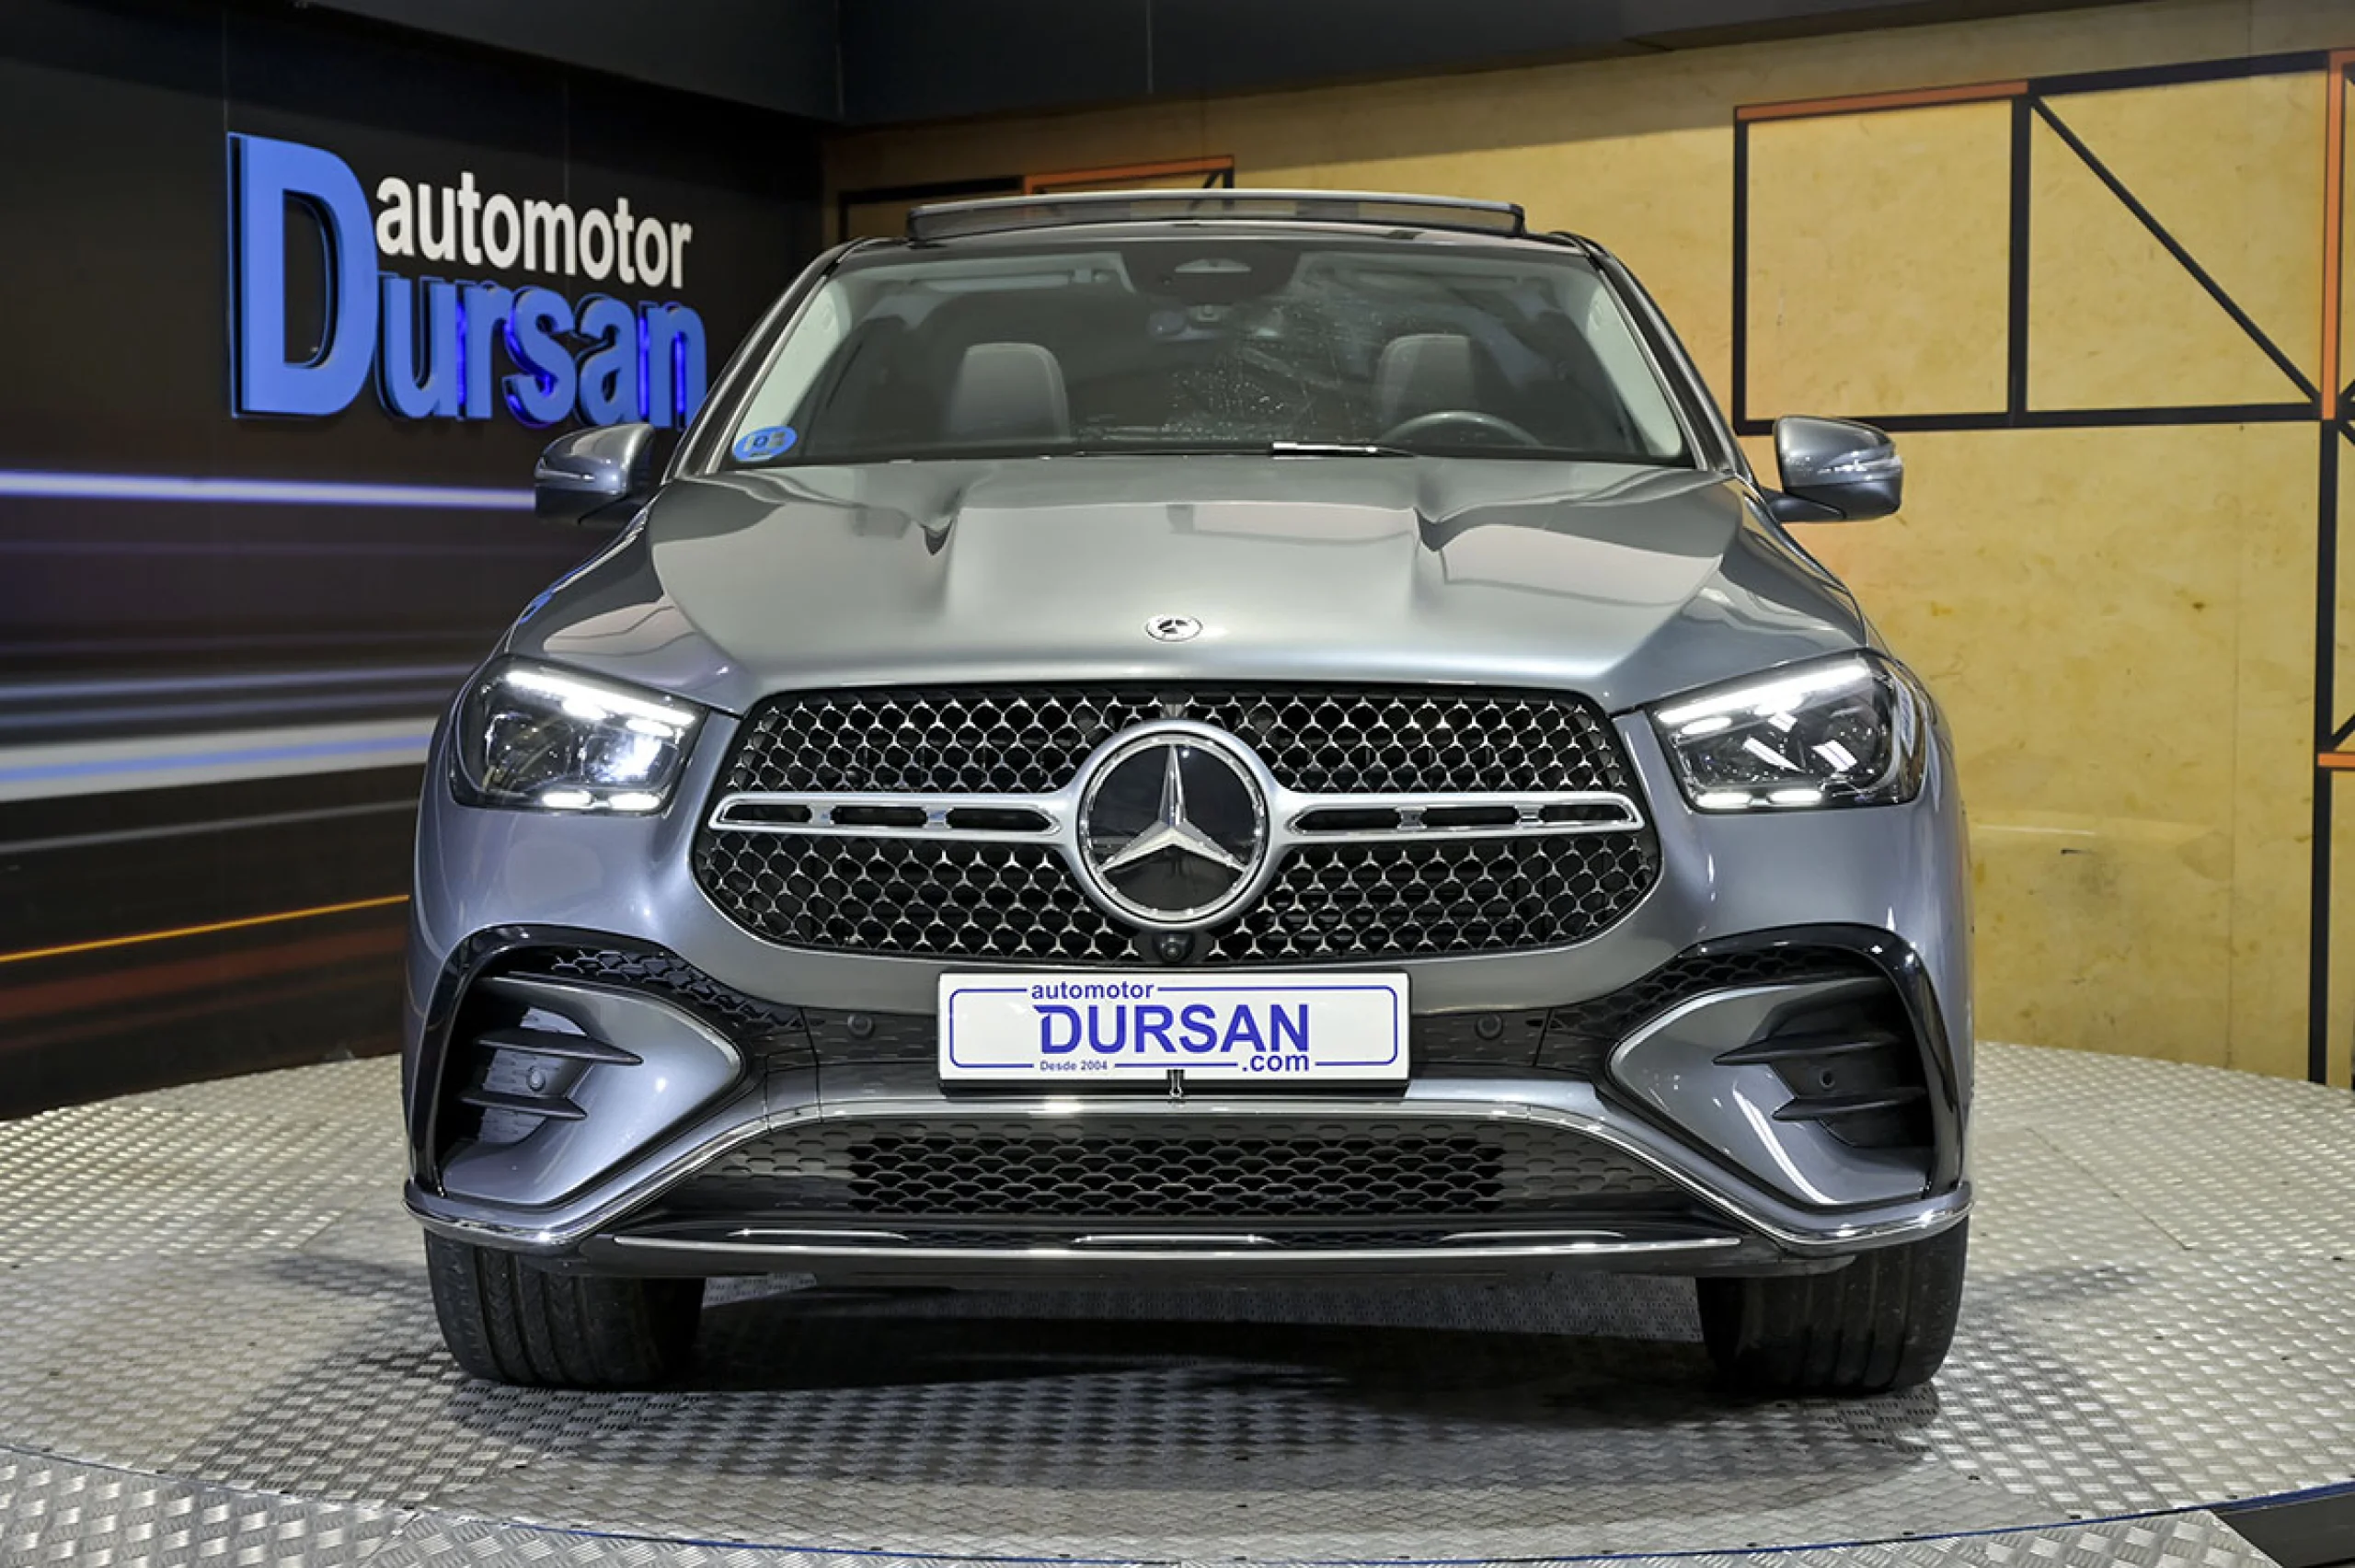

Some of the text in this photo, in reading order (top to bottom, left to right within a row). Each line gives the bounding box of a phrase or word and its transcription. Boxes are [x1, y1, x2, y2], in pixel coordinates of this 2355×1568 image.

[375, 172, 693, 289] automotor
[227, 131, 707, 431] Dursan
[1031, 980, 1155, 1000] automotor
[1032, 1004, 1310, 1054] DURSAN
[1040, 1059, 1108, 1070] Desde 2004
[1242, 1054, 1310, 1072] .com
